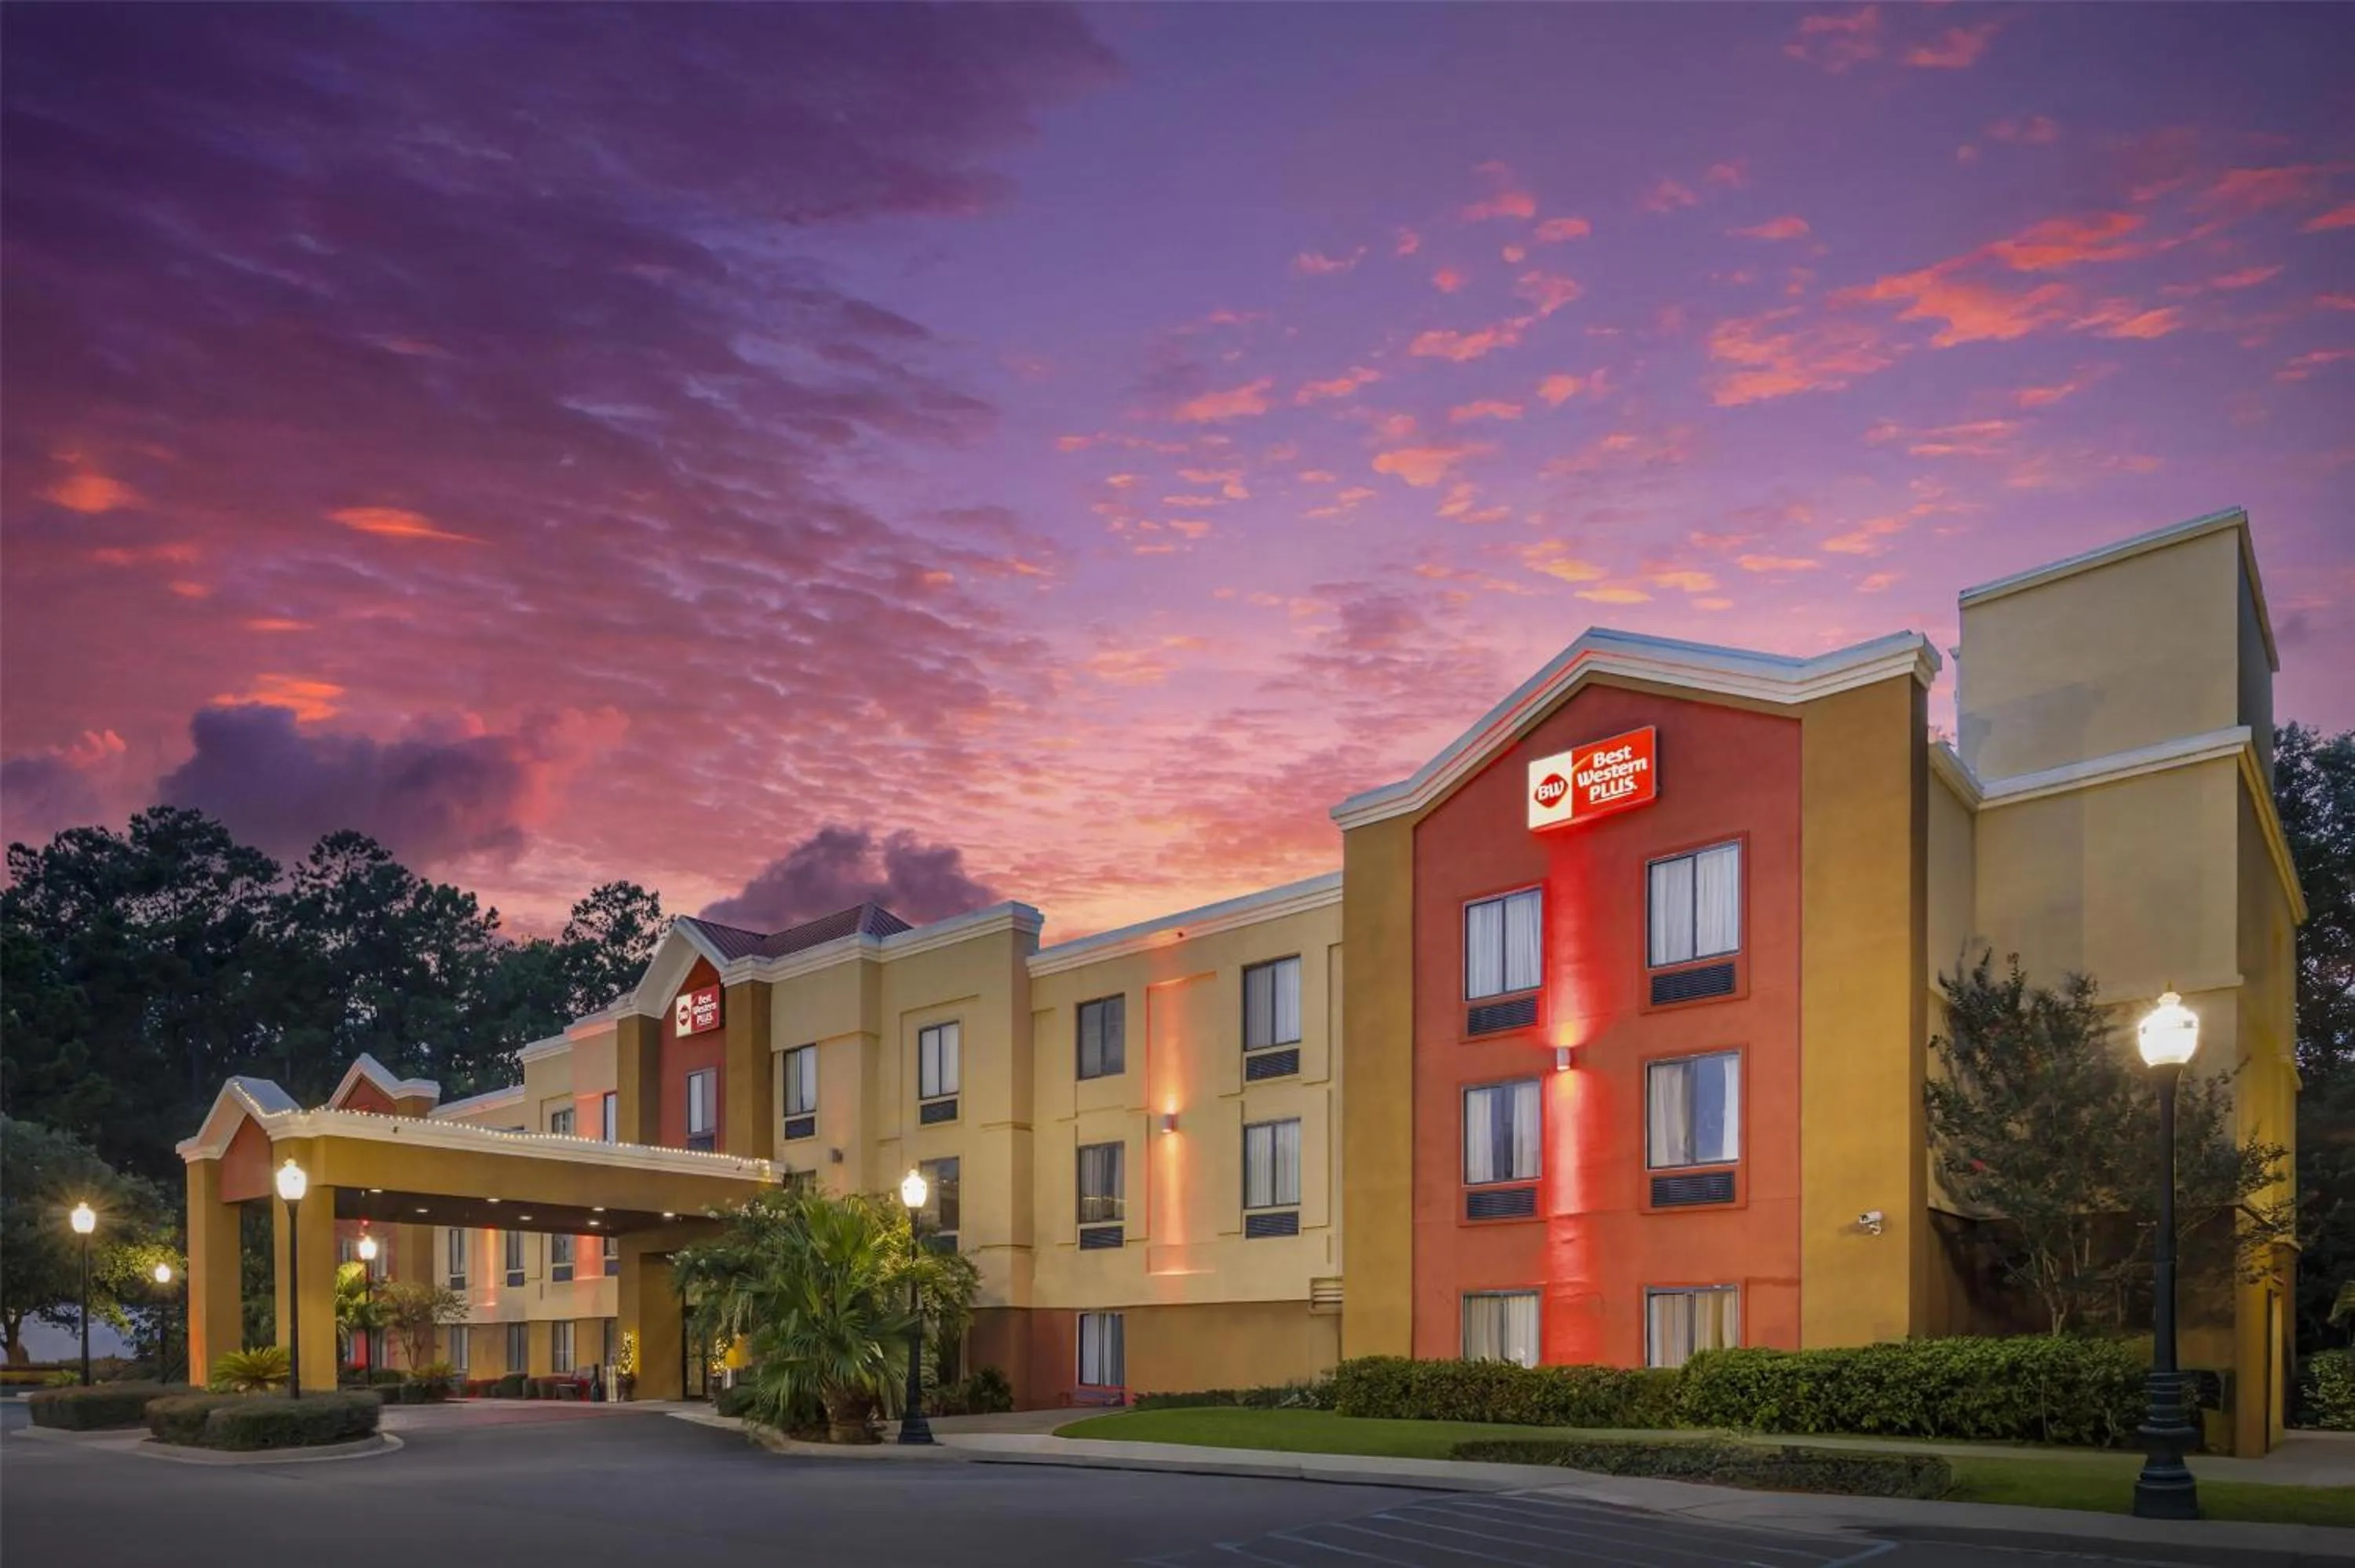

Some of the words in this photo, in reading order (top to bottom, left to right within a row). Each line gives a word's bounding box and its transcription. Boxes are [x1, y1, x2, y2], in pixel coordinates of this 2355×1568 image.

[1593, 746, 1632, 768] Best
[1576, 758, 1648, 788] Western
[1538, 780, 1565, 800] BW
